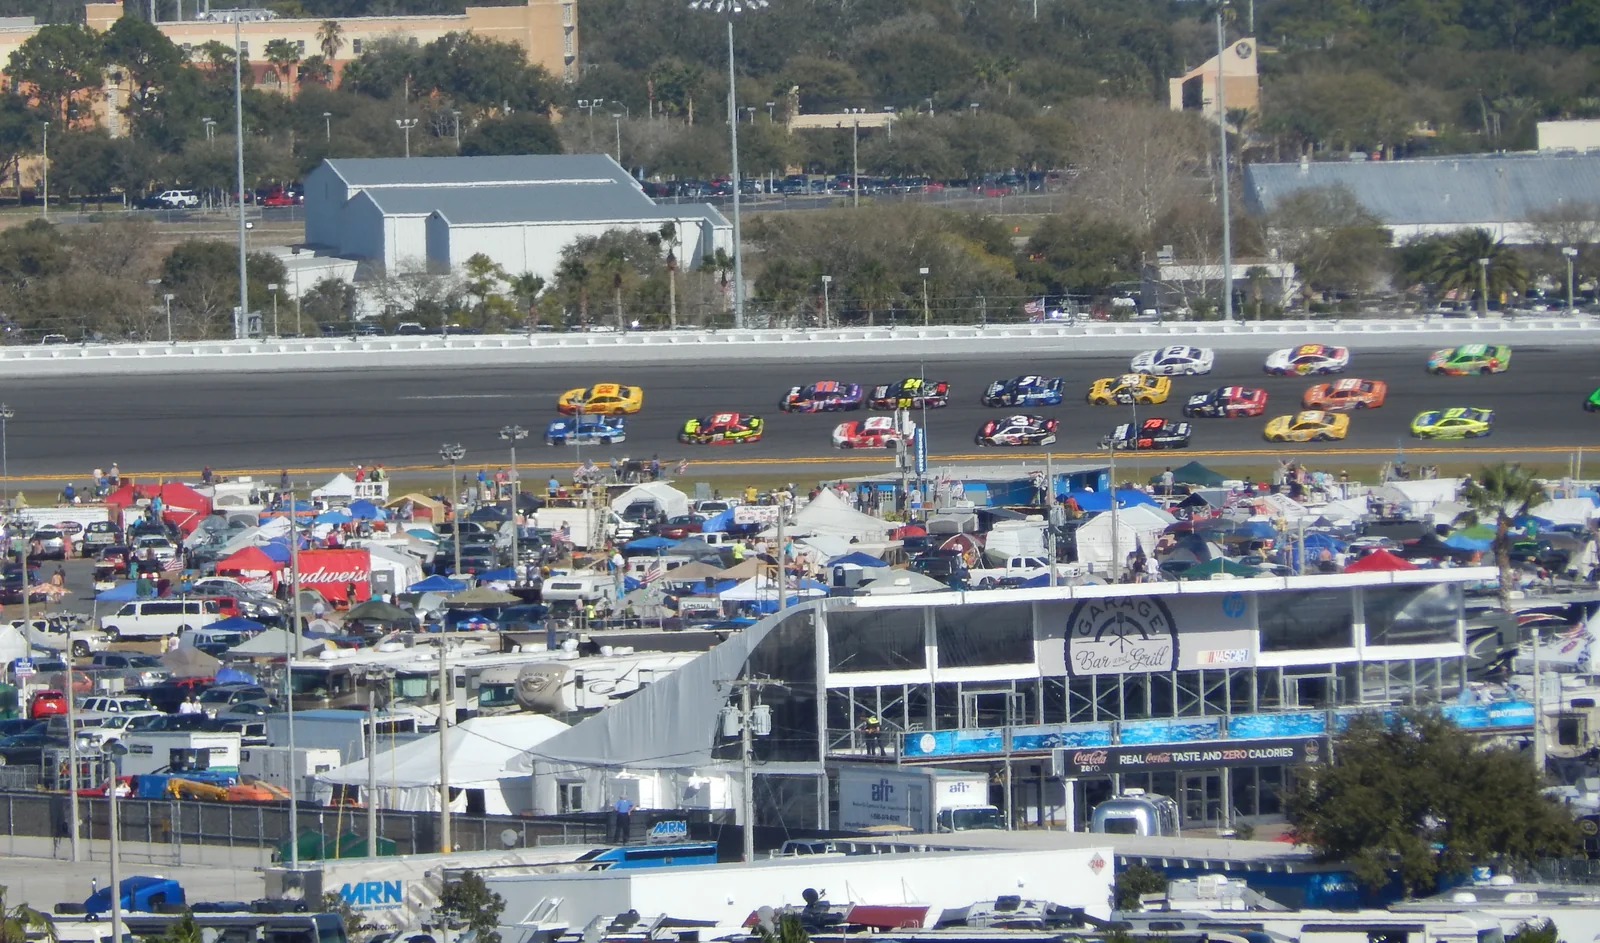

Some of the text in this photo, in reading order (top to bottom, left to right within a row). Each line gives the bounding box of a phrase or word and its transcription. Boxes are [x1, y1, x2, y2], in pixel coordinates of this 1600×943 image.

[1168, 346, 1185, 355] 2
[1164, 365, 1174, 374] 2
[903, 378, 922, 389] 24
[1019, 375, 1037, 386] 5
[815, 381, 836, 392] 11
[1222, 387, 1233, 397] 1
[1011, 415, 1029, 426] 3
[1144, 419, 1163, 429] 78
[1078, 596, 1164, 636] GARAGE
[1075, 651, 1111, 671] Bar
[1128, 645, 1170, 671] Grill
[1207, 649, 1249, 663] NASCAR
[1119, 754, 1144, 765] REAL
[1172, 751, 1201, 762] TASTE
[1202, 751, 1222, 761] AND
[1223, 749, 1247, 760] ZERO
[1248, 747, 1294, 759] CALORIES
[872, 778, 893, 802] afr
[949, 782, 970, 793] afr
[652, 820, 687, 834] MRN
[1090, 859, 1104, 869] 240
[340, 880, 402, 904] MRN
[358, 923, 397, 931] MRN.com
